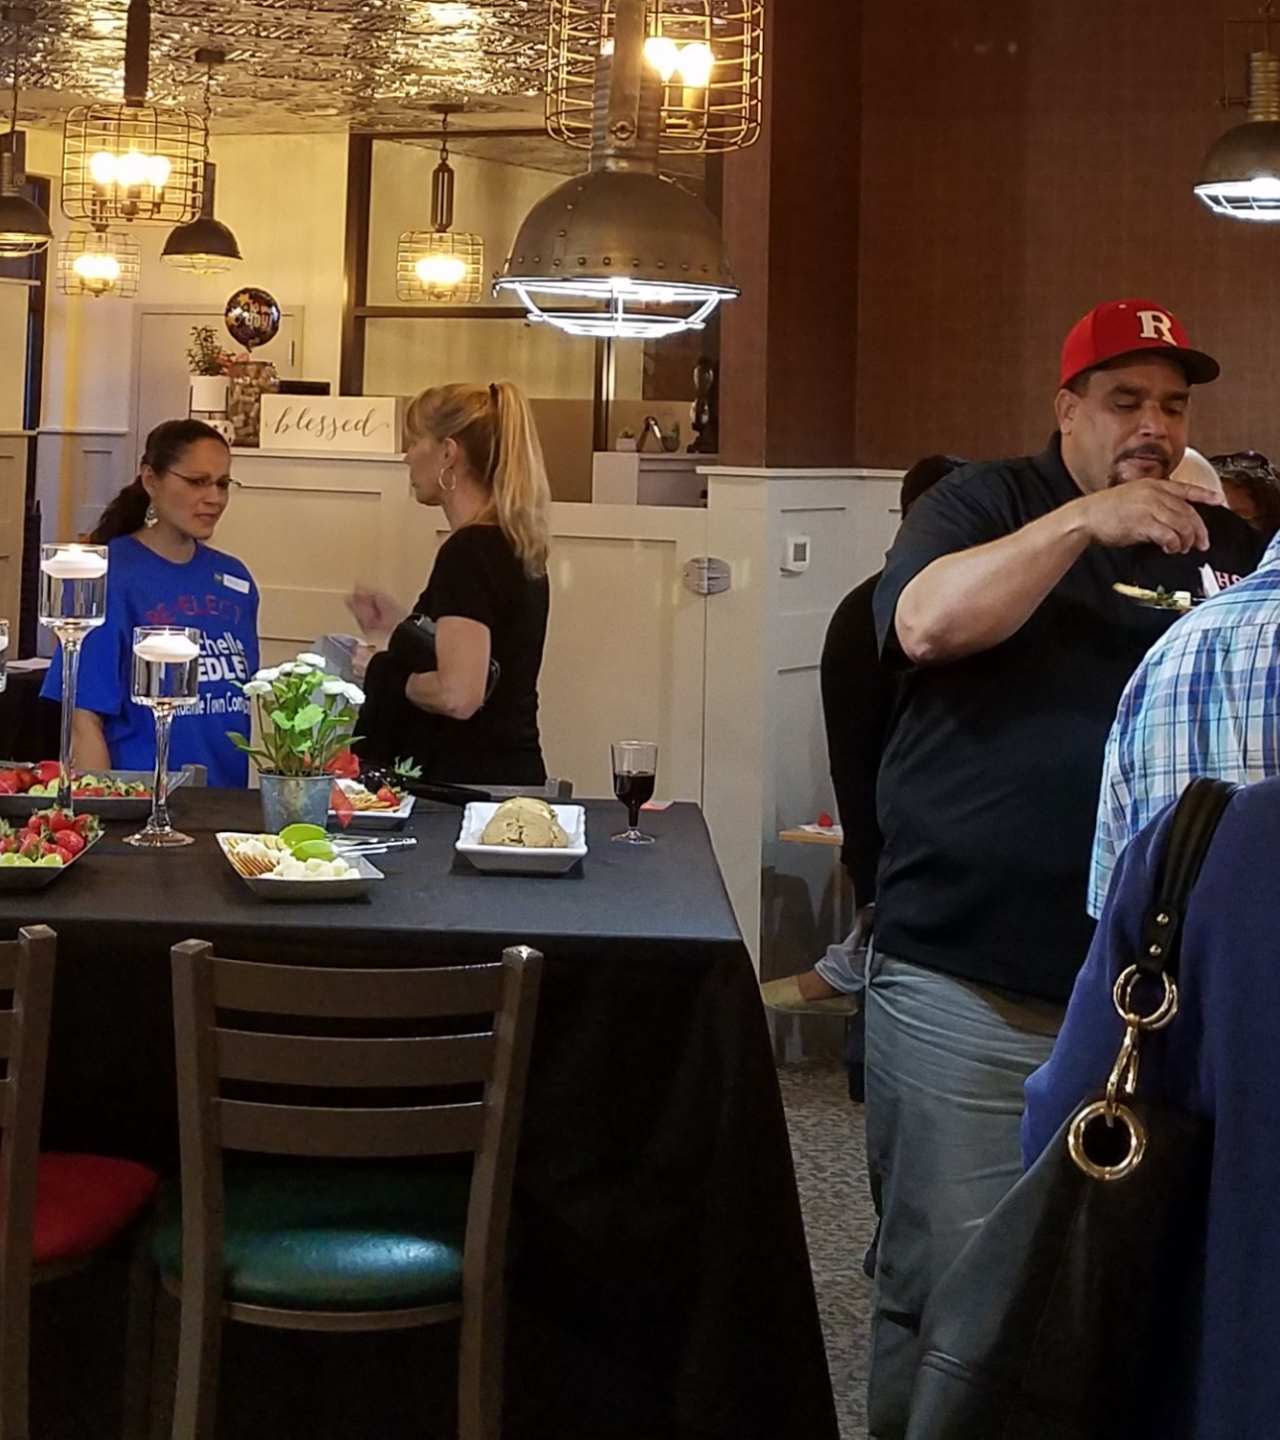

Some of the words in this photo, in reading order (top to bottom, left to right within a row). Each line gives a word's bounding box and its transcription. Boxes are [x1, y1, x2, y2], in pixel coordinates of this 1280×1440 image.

[1136, 310, 1177, 346] R
[271, 406, 380, 441] blessed
[198, 631, 245, 657] chelle
[197, 655, 249, 682] EDLE
